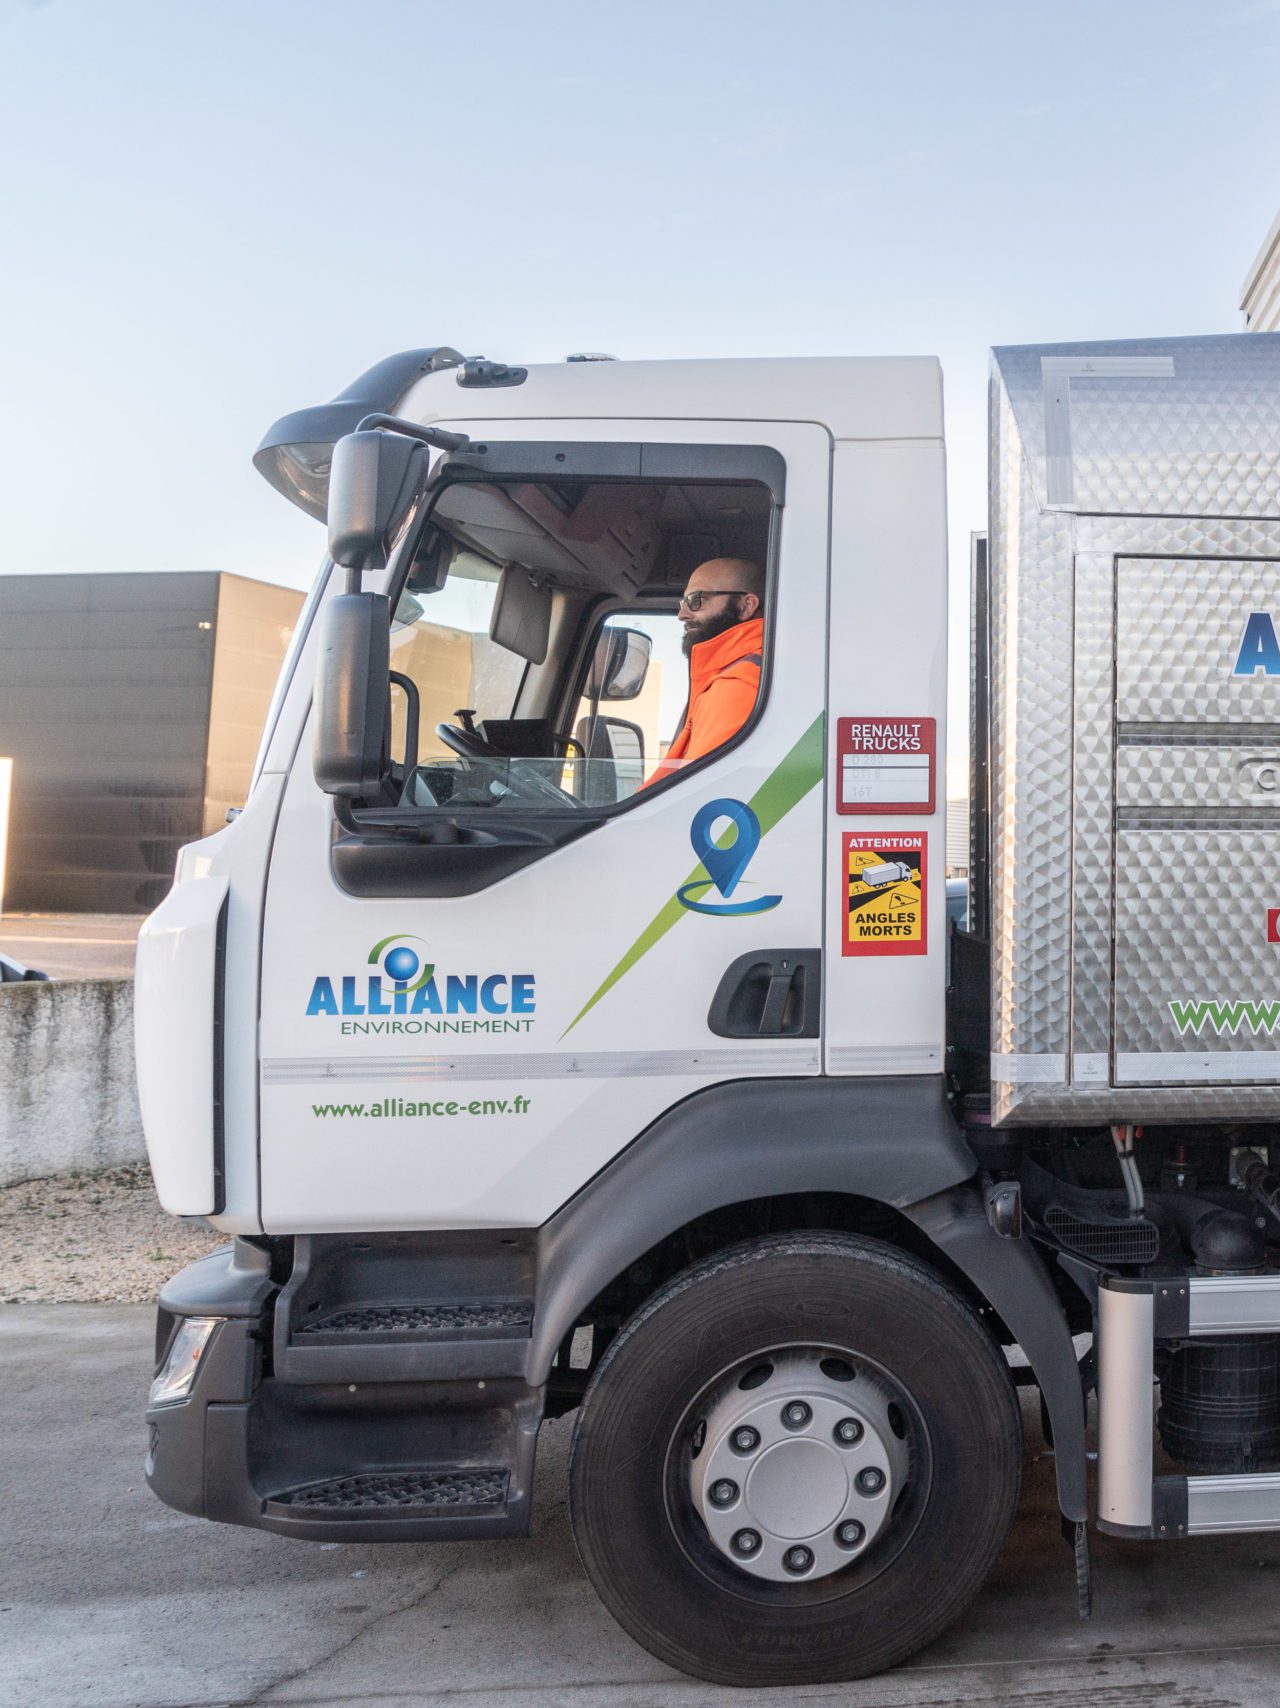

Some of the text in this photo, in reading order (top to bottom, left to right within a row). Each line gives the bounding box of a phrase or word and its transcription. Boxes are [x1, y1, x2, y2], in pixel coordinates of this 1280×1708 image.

[851, 724, 921, 737] RENAULT
[852, 738, 921, 750] TRUCKS
[852, 787, 872, 797] 16T
[849, 838, 922, 848] ATTENTION
[855, 912, 916, 924] ANGLES
[859, 925, 912, 936] MORTS
[305, 974, 537, 1016] ALLIANCE
[341, 1019, 535, 1035] ENVIRONNEMENT
[312, 1095, 531, 1118] www.alliance-env.fr
